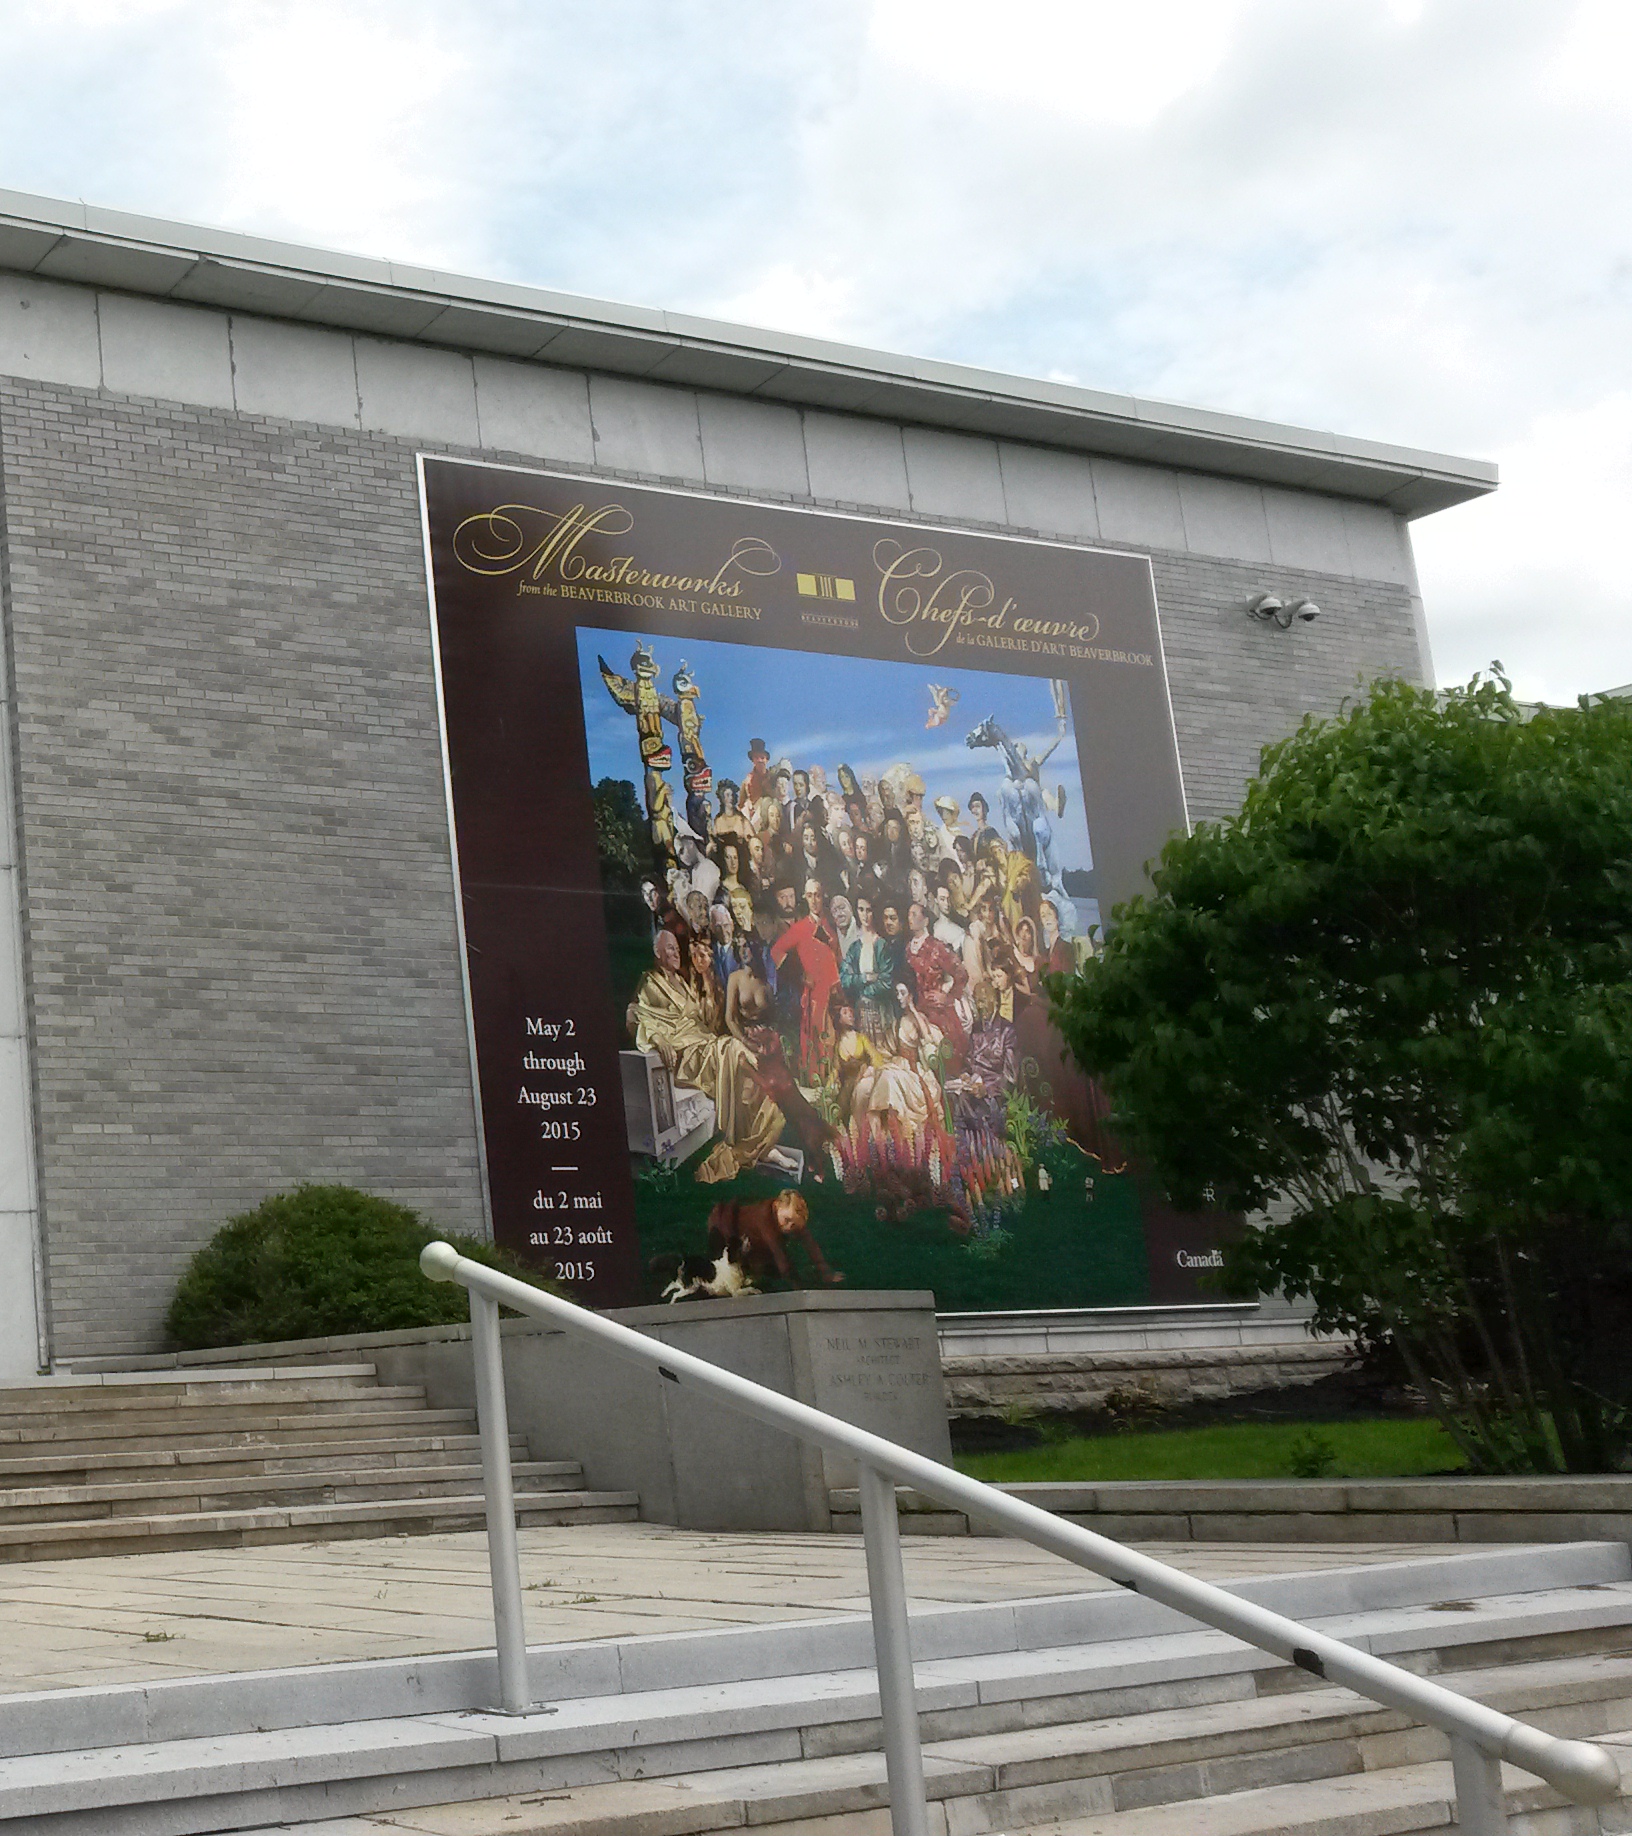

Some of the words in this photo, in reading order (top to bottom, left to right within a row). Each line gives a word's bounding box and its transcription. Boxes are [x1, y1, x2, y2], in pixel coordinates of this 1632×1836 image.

[453, 503, 782, 597] Masterworks
[517, 580, 541, 596] from
[543, 583, 557, 597] the
[560, 584, 665, 610] BEAVERBROOK
[669, 597, 698, 613] ART
[701, 601, 762, 620] GALLERY
[956, 631, 965, 644] de
[967, 633, 974, 645] la
[976, 633, 1029, 651] GALERIE
[1031, 640, 1067, 656] D'ART
[1069, 645, 1153, 666] BEAVERBROOK
[525, 1017, 561, 1042] May
[565, 1019, 576, 1037] 2
[523, 1050, 586, 1076] through
[517, 1085, 573, 1110] August
[577, 1087, 597, 1107] 23
[541, 1121, 581, 1141] 2015
[533, 1189, 554, 1210] du
[557, 1191, 569, 1209] 2
[573, 1191, 603, 1209] mai
[529, 1229, 549, 1245] au
[553, 1226, 573, 1245] 23
[578, 1225, 614, 1244] août
[1176, 1249, 1225, 1268] Canada
[555, 1261, 596, 1281] 2015
[825, 1337, 851, 1351] NEIL
[874, 1337, 921, 1350] STEWART
